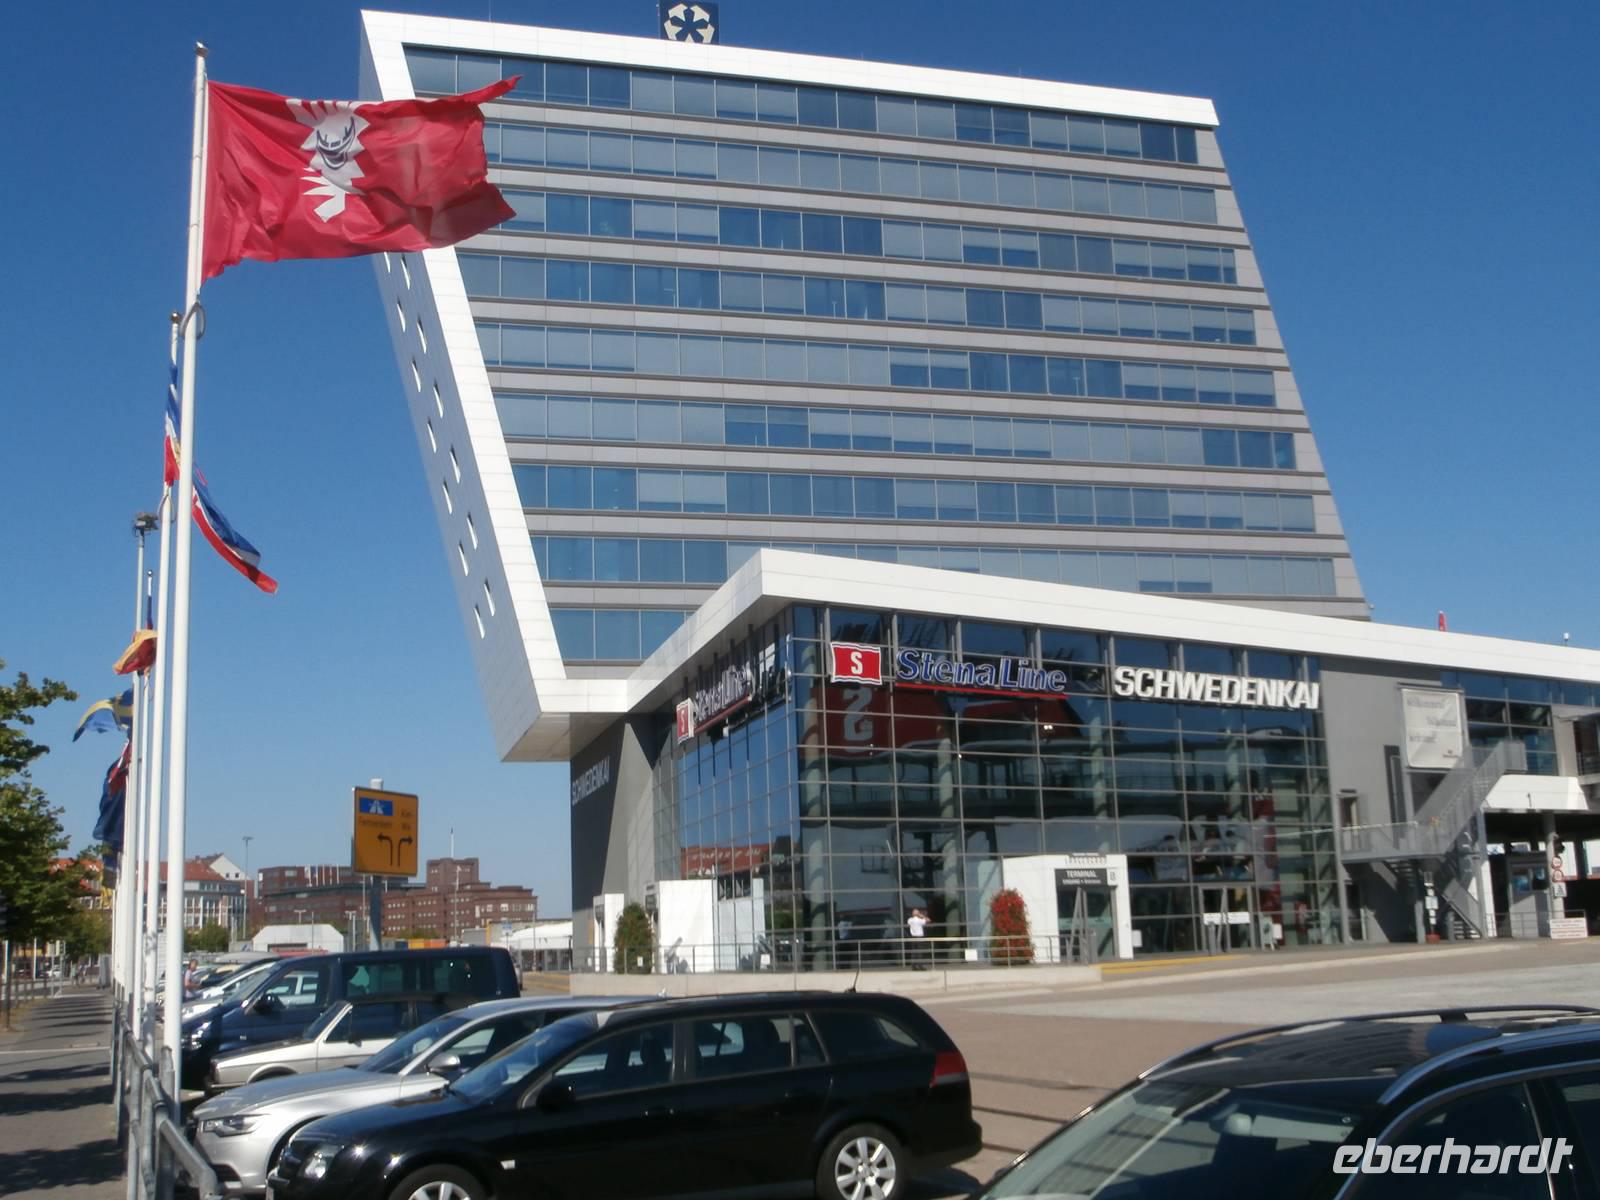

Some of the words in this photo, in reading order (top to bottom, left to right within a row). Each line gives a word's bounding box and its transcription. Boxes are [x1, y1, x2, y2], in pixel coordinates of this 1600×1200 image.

[850, 651, 863, 675] S
[895, 647, 997, 687] Stena
[999, 656, 1067, 692] Line
[1114, 665, 1321, 710] SCHWEDENKAI
[1065, 869, 1098, 879] TERMINAL
